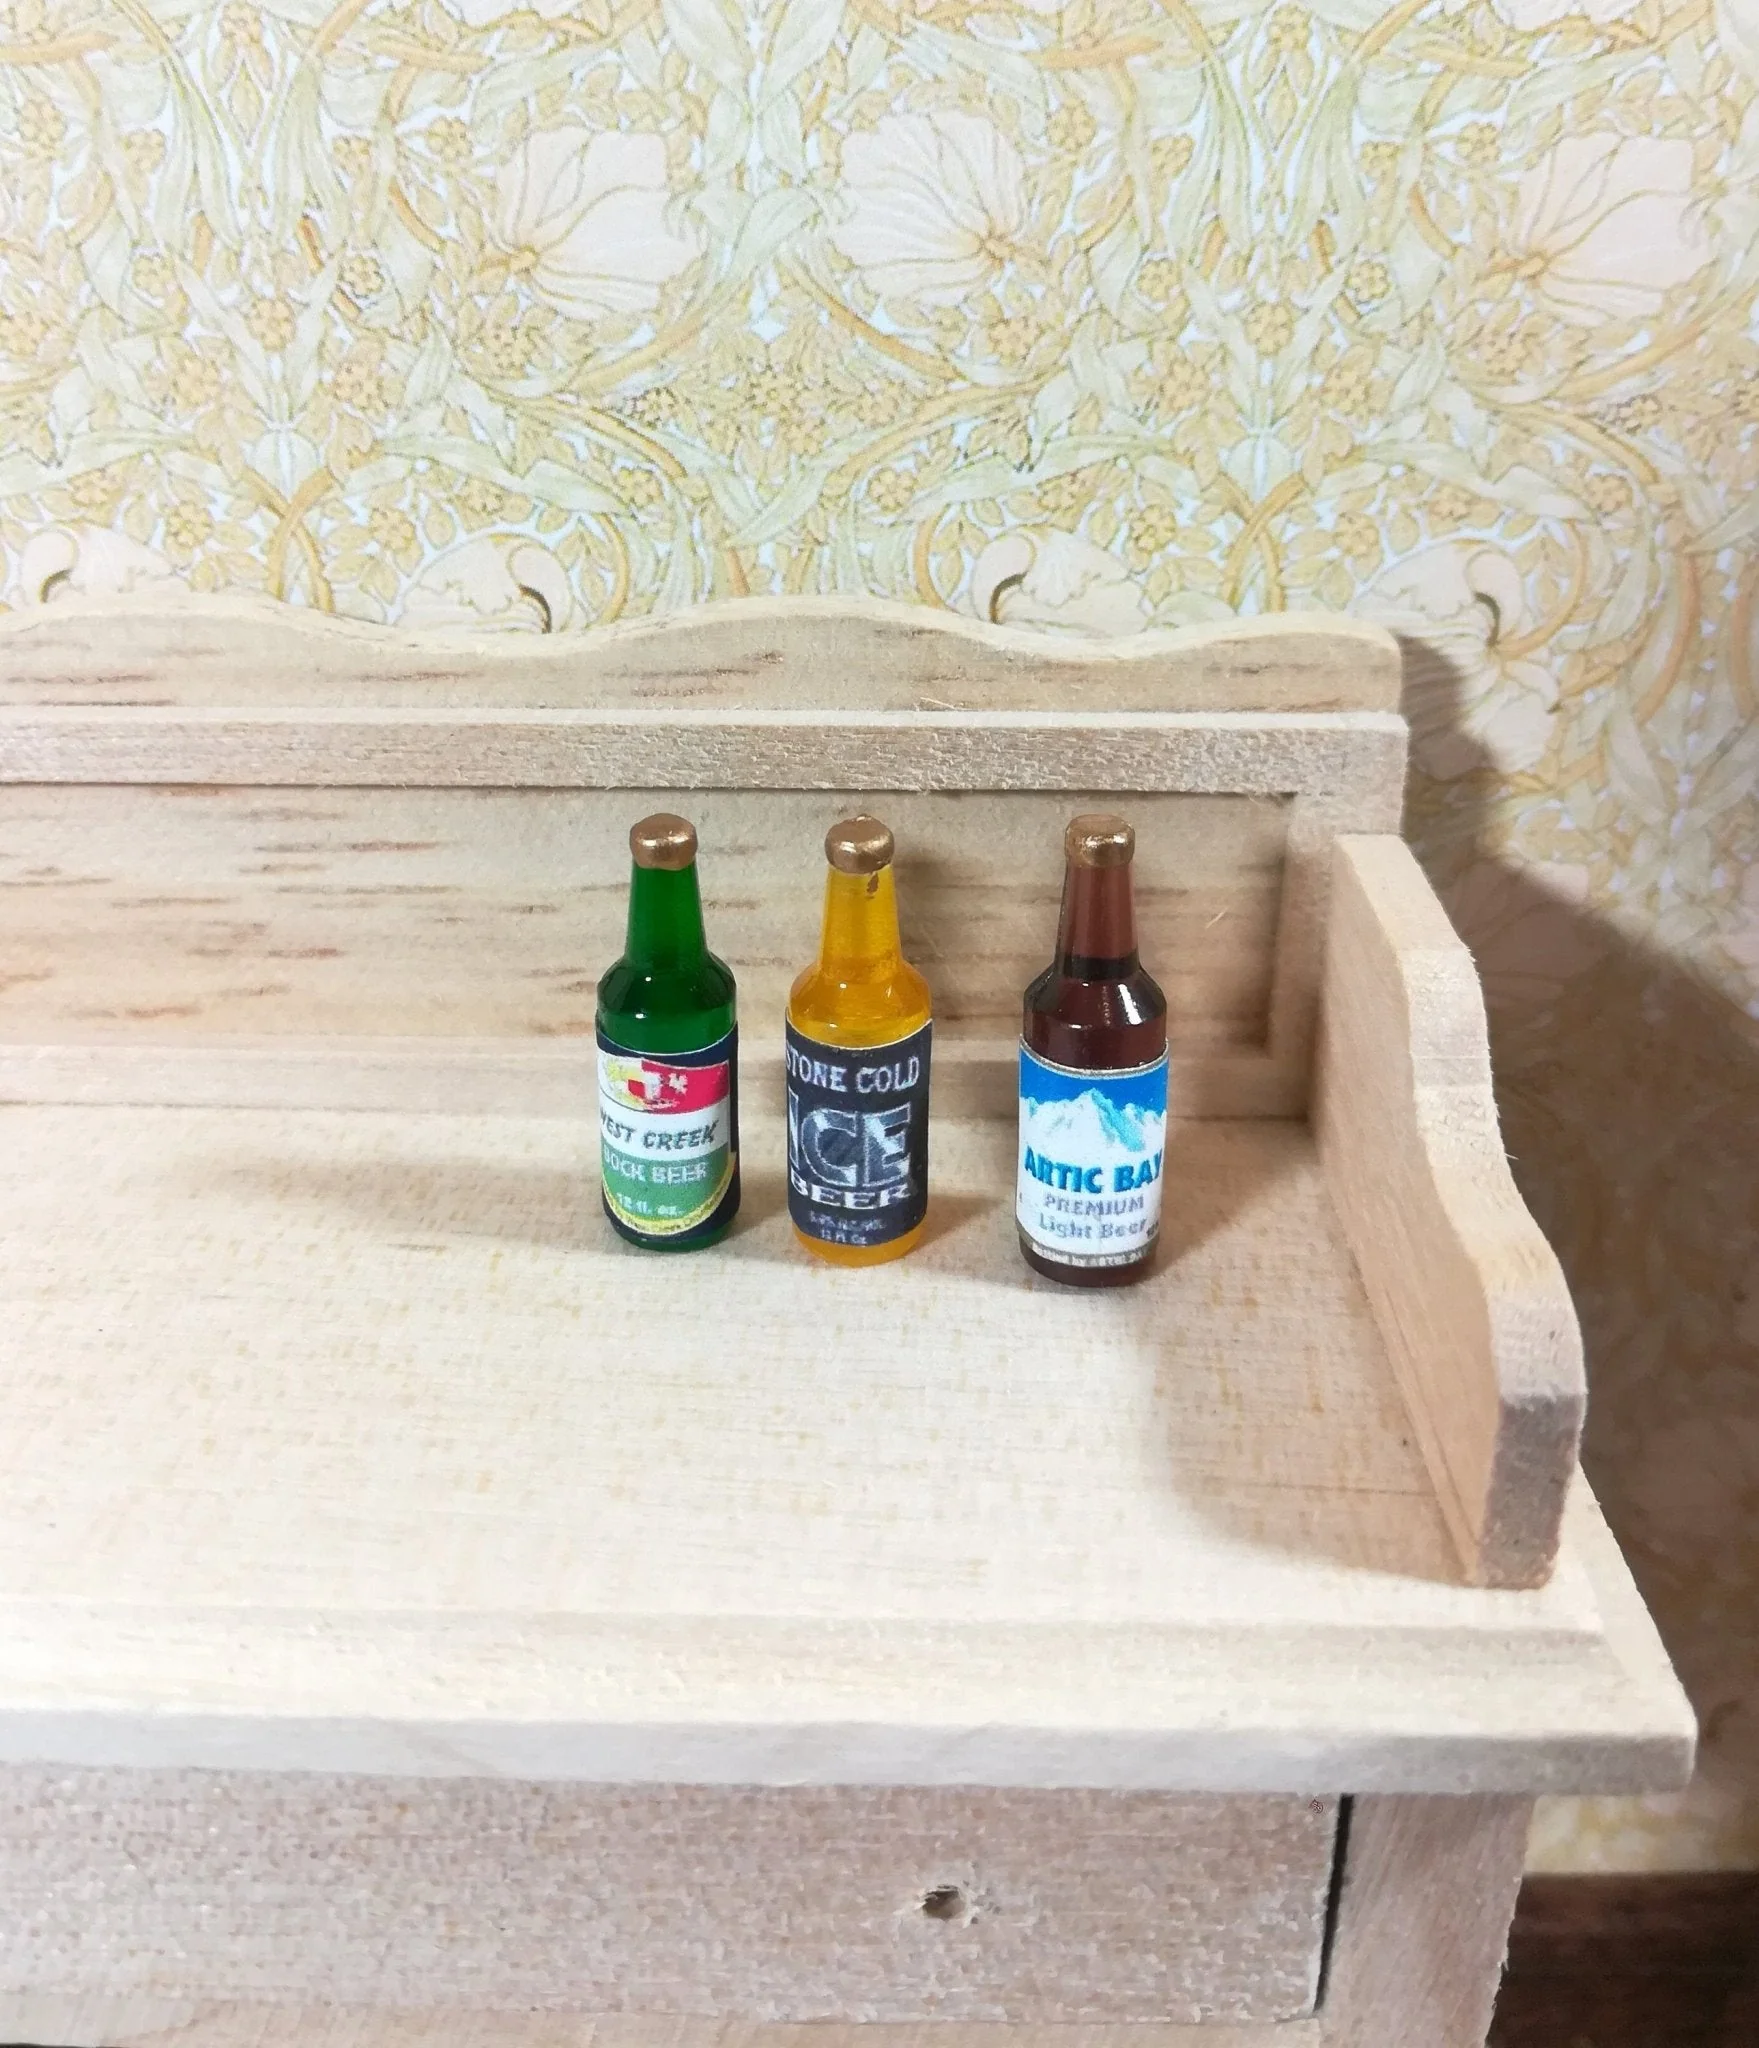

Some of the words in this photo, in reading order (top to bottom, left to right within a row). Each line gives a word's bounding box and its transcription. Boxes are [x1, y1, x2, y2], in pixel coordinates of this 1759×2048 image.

[856, 1056, 920, 1094] COLD
[643, 1120, 719, 1151] CREEK
[789, 1088, 911, 1187] ICE
[652, 1161, 708, 1184] BEER
[1024, 1145, 1103, 1194] ARTIC
[1115, 1148, 1163, 1193] BAY
[791, 1166, 911, 1210] BEER
[1045, 1194, 1144, 1216] PREMIUM
[1039, 1212, 1093, 1239] Light
[1100, 1218, 1147, 1239] Beer
